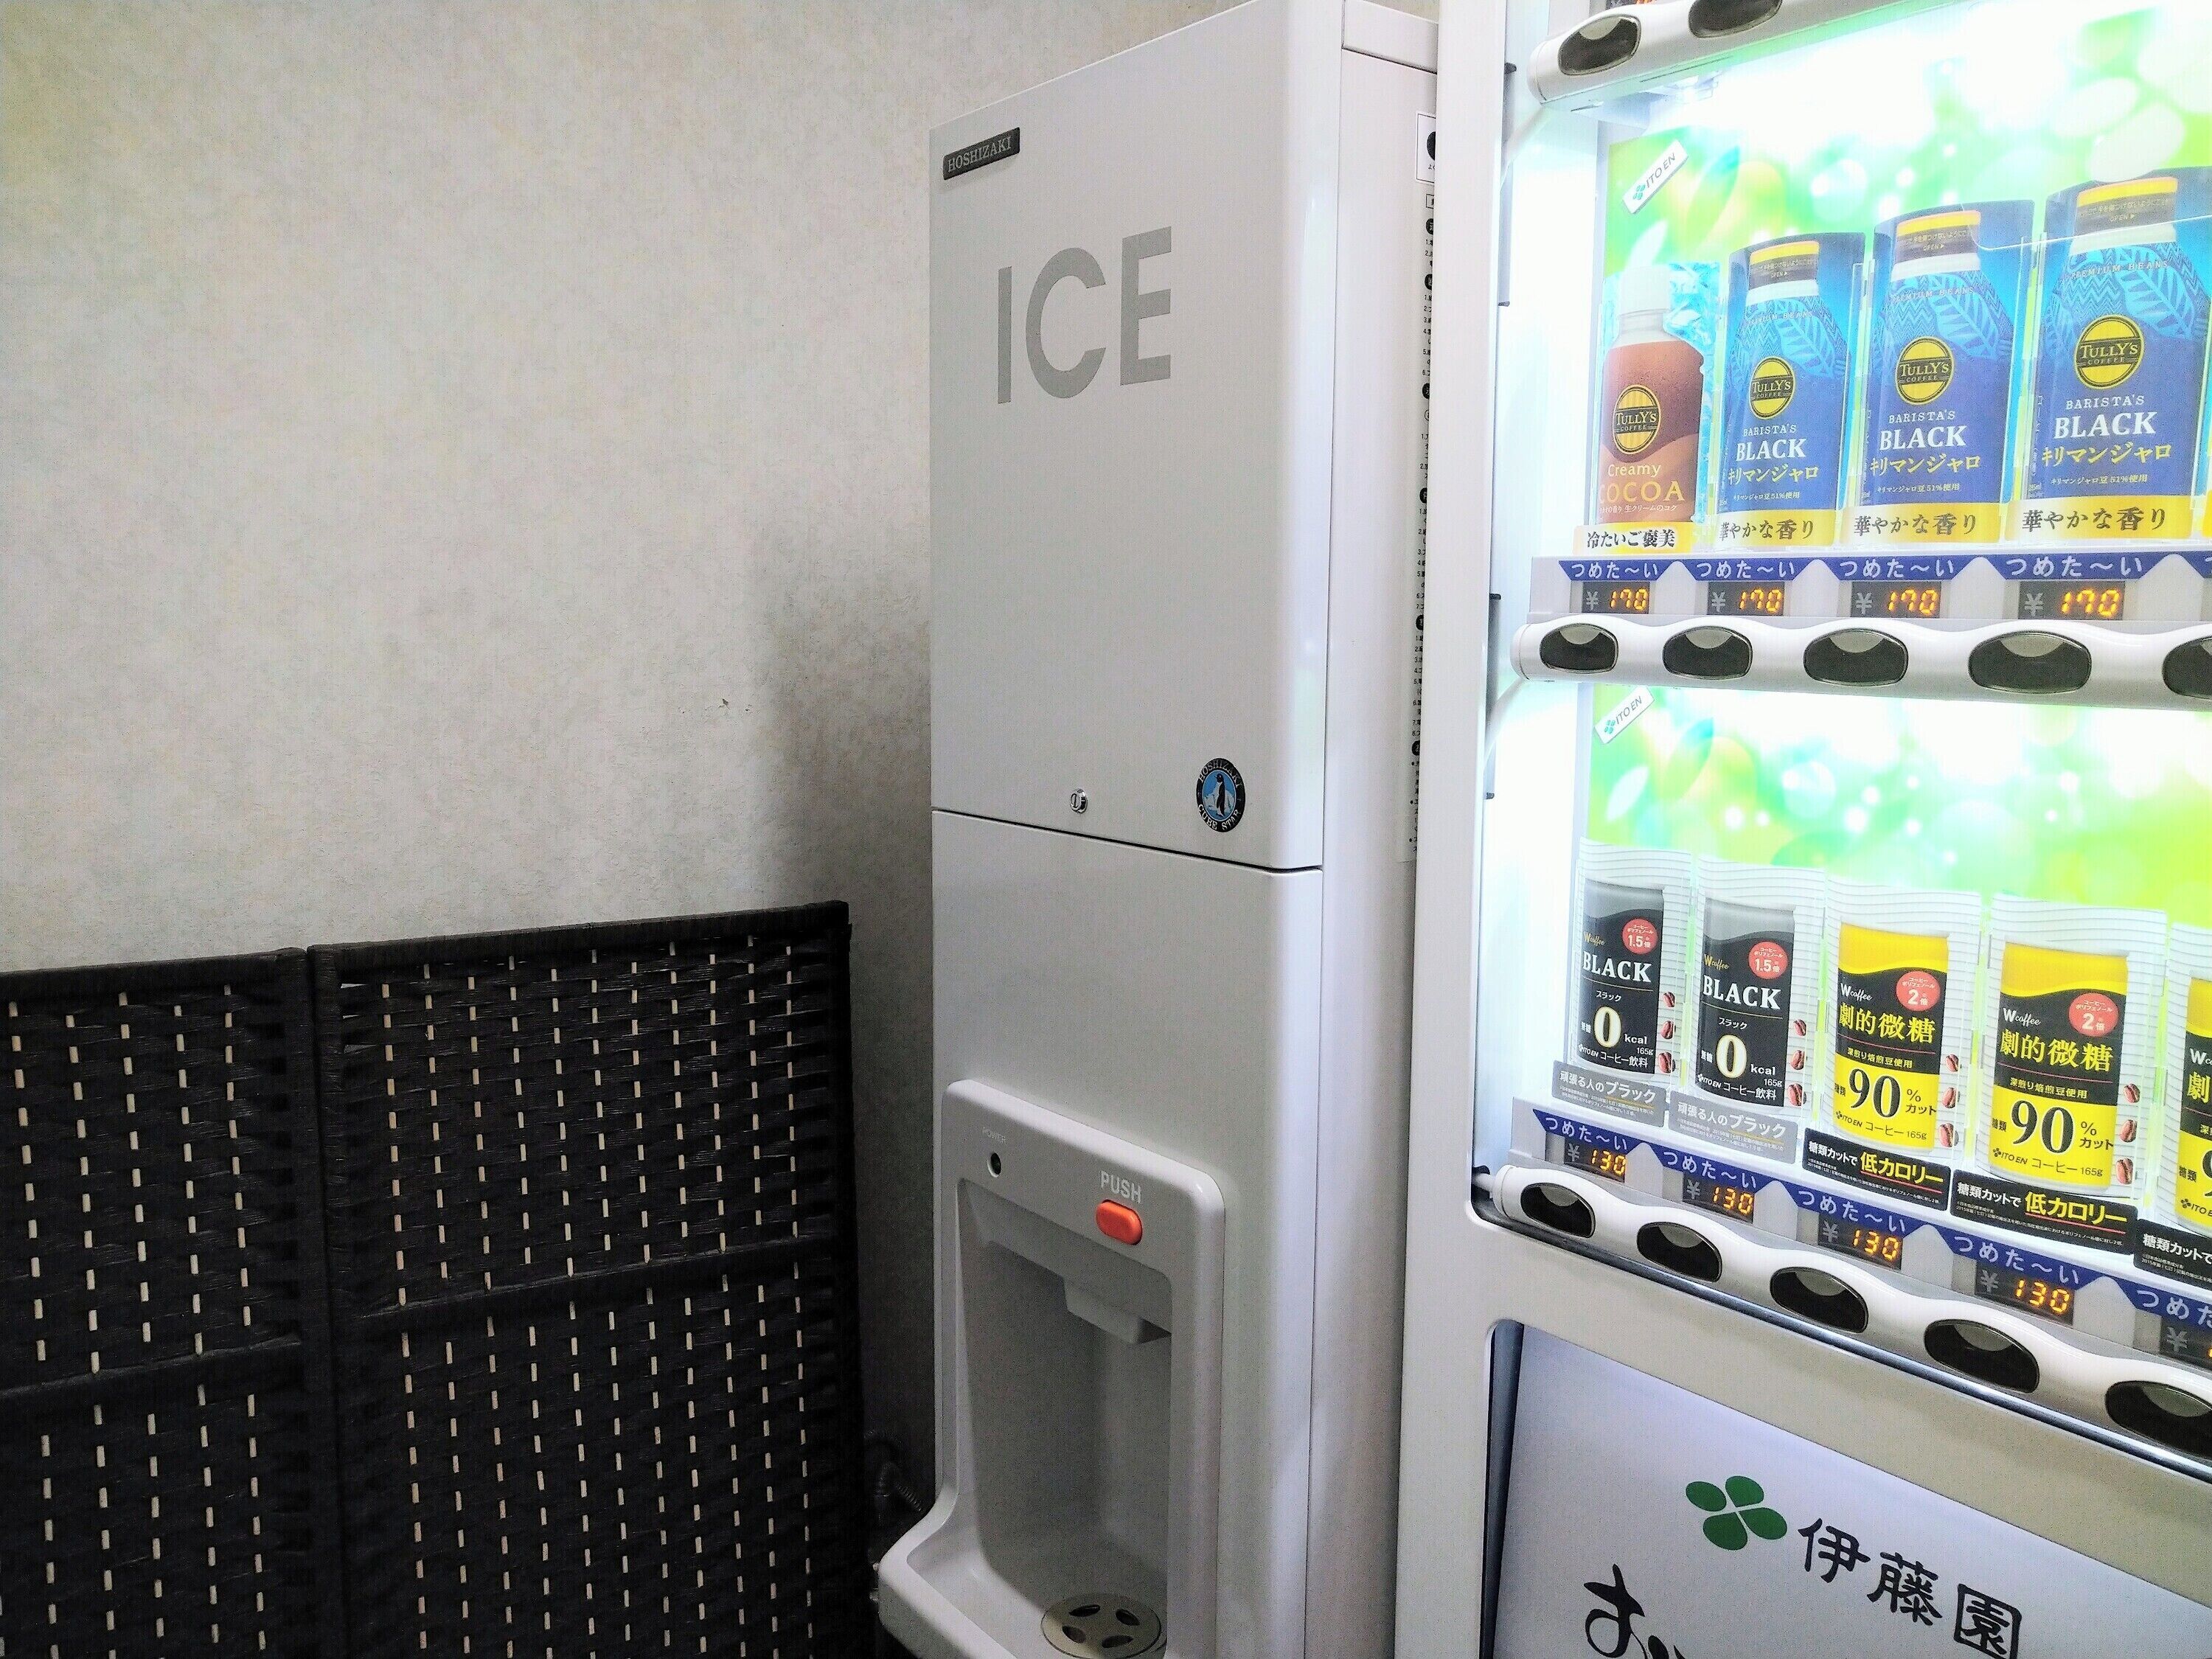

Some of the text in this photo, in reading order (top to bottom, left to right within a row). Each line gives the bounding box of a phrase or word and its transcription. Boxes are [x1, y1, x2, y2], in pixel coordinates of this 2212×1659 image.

[947, 135, 1012, 173] HOSHIZAKI
[1646, 152, 1676, 188] ITO EN
[2128, 260, 2168, 271] BEANS
[998, 226, 1172, 404] ICE
[2080, 341, 2139, 359] TULLY'S
[2087, 356, 2125, 365] COFFEE
[1899, 361, 1950, 378] TULLY'S
[1906, 374, 1938, 383] COFFEE
[1751, 379, 1792, 394] TULLY'S
[1756, 392, 1781, 400] COFFEE
[2065, 394, 2145, 410] BARISTA'S
[1615, 410, 1658, 425] TULLY'S
[1618, 423, 1648, 432] COFFEE
[1888, 408, 1956, 425] BARISTA'S
[2053, 411, 2158, 439] BLACK
[1743, 423, 1797, 437] BARISTA'S
[1879, 425, 1967, 451] BLACK
[1736, 438, 1806, 462] BLACK
[2041, 442, 2172, 467] キリマンジャロ
[1607, 464, 1662, 479] Creamy
[1728, 463, 1819, 486] キリマンジャロ
[1870, 453, 1981, 477] キリマンジャロ
[1599, 480, 1686, 504] COCOA
[1719, 518, 1814, 541] 華やかな香り
[1853, 512, 1977, 537] 華やかな香り
[2022, 506, 2166, 532] 華やかな香り
[1587, 529, 1677, 549] 冷たいご褒美
[1609, 588, 1649, 611] 170
[1739, 590, 1782, 612] 170
[1888, 588, 1938, 616] 170
[2061, 588, 2120, 616] 170
[1615, 695, 1643, 725] ITO EN
[1199, 759, 1242, 788] HOSHIZAKI
[1198, 804, 1242, 830] CUBE STAR
[1582, 950, 1652, 983] BLACK
[1596, 990, 1621, 1002] ブラック
[1703, 974, 1781, 1010] BLACK
[1593, 1005, 1622, 1048] 0
[1624, 1033, 1648, 1045] kcal
[1718, 1017, 1748, 1030] ブラック
[1838, 1001, 1936, 1045] 劇的微糖
[1583, 1047, 1649, 1068] ITO EN コーヒー飲料
[1635, 1047, 1655, 1056] 165g
[1716, 1034, 1747, 1079] 0
[1750, 1063, 1775, 1076] kcal
[1999, 1027, 2114, 1072] 劇的微糖
[1559, 1070, 1656, 1105] 頑張る人のブラック
[1703, 1077, 1777, 1102] ITO EN コーヒー飲料
[1763, 1078, 1784, 1088] 165g
[1848, 1068, 1901, 1118] 90
[1906, 1088, 1921, 1103] %
[2187, 1071, 2211, 1104] 劇
[1677, 1101, 1787, 1139] 頑張る人のブラック
[1905, 1104, 1937, 1116] カット
[1841, 1115, 1927, 1140] ITO EN コーヒー 165g
[2011, 1099, 2074, 1154] 90
[2080, 1121, 2097, 1136] %
[2079, 1138, 2115, 1151] カット
[1590, 1149, 1627, 1175] 130
[1808, 1140, 1858, 1166] 糖類カットで
[1860, 1151, 1944, 1184] 低カロリー
[2000, 1152, 2104, 1178] ITO EN コーヒー 165g
[2178, 1165, 2198, 1183] 糖類
[1100, 1170, 1142, 1203] PUSH
[1712, 1186, 1754, 1214] 130
[1957, 1181, 2022, 1208] 糖類カットで
[2024, 1191, 2128, 1225] 低カロリー
[2190, 1203, 2207, 1215] ITO
[1852, 1229, 1900, 1261] 130
[2015, 1279, 2070, 1314] 130
[1798, 1517, 2023, 1659] 伊藤園
